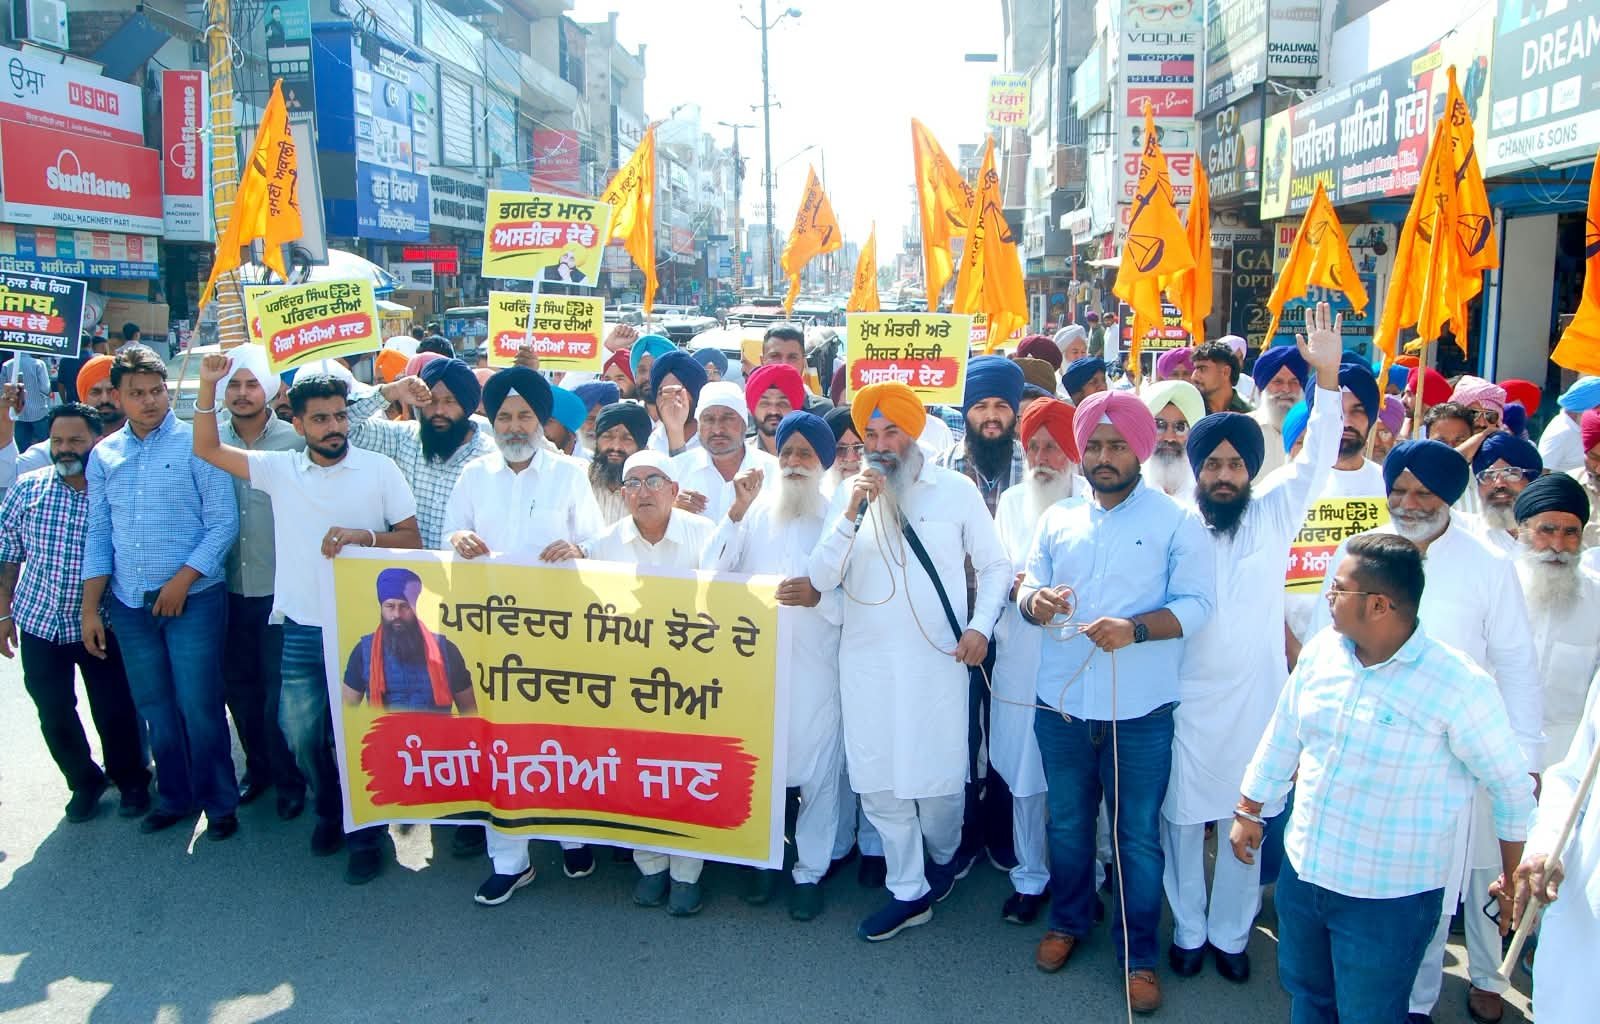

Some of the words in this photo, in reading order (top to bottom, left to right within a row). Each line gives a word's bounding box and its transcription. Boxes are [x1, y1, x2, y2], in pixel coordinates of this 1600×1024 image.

[1128, 32, 1196, 45] VOGUE
[1269, 42, 1319, 52] DHALIWAL
[1521, 14, 1600, 80] DREAM
[1269, 54, 1318, 64] TRADERS
[69, 82, 119, 115] USHA
[1130, 91, 1188, 114] Ry-Ban
[182, 86, 195, 180] Sunflame
[1498, 136, 1535, 159] CHANNI
[1537, 132, 1544, 150] &
[1548, 123, 1577, 147] SONS
[1209, 134, 1239, 174] GARV
[46, 166, 131, 199] Sunflame
[1209, 171, 1239, 198] OPTICAL
[52, 212, 75, 223] JINDAL
[77, 214, 113, 226] MACHINERY
[114, 217, 130, 226] MART
[499, 197, 553, 219] ਭਗਵੰਤ
[557, 202, 595, 221] ਮਾਨ
[566, 223, 595, 246] ਦੇਵੇ
[1237, 248, 1272, 270] GA
[7, 277, 28, 289] ਨਾਲ
[49, 280, 71, 295] ਰਿਹਾ
[265, 294, 304, 313] ਪਰਵਿੰਦਰ
[306, 287, 329, 303] ਸਿੰਘ
[351, 283, 361, 296] ਦੇ
[544, 300, 565, 315] ਸਿੰਘ
[586, 303, 594, 316] ਦੇ
[282, 304, 328, 325] ਪਰਿਵਾਰ
[330, 298, 362, 314] ਦੀਆਂ
[564, 315, 592, 331] ਦੀਆਂ
[860, 320, 880, 340] ਮੁੱਖ
[884, 318, 921, 337] ਮੰਤਰੀ
[926, 320, 951, 338] ਅਤੇ
[4, 331, 26, 343] ਮਾਨ
[28, 334, 68, 348] ਸਰਕਾਰ!
[274, 334, 295, 353] ਮੰਗਾਂ
[298, 324, 336, 345] ਮੰਨੀਆਂ
[339, 321, 365, 336] ਜਾਣ
[567, 341, 592, 354] ਜਾਣ
[904, 342, 942, 361] ਮੰਤਰੀ
[918, 364, 945, 385] ਦੇਣ
[1319, 504, 1345, 521] ਸਿੰਘ
[1368, 504, 1378, 520] ਦੇ
[1293, 523, 1342, 543] ਰਿਵਾਰ
[1302, 551, 1333, 572] ਮੰਨੀ
[438, 594, 572, 641] ਪਰਵਿੰਦਰ
[584, 602, 653, 649] ਸਿੰਘ
[664, 607, 720, 655] ਝੋਟੇ
[731, 615, 760, 658] ਦੇ
[476, 653, 617, 709] ਪਰਿਵਾਰ
[630, 666, 723, 721] ਦੀਆਂ
[397, 734, 481, 788] ਮੰਗਾਂ
[488, 738, 622, 796] ਮੰਨੀਆਂ
[636, 757, 723, 802] ਜਾਣ
